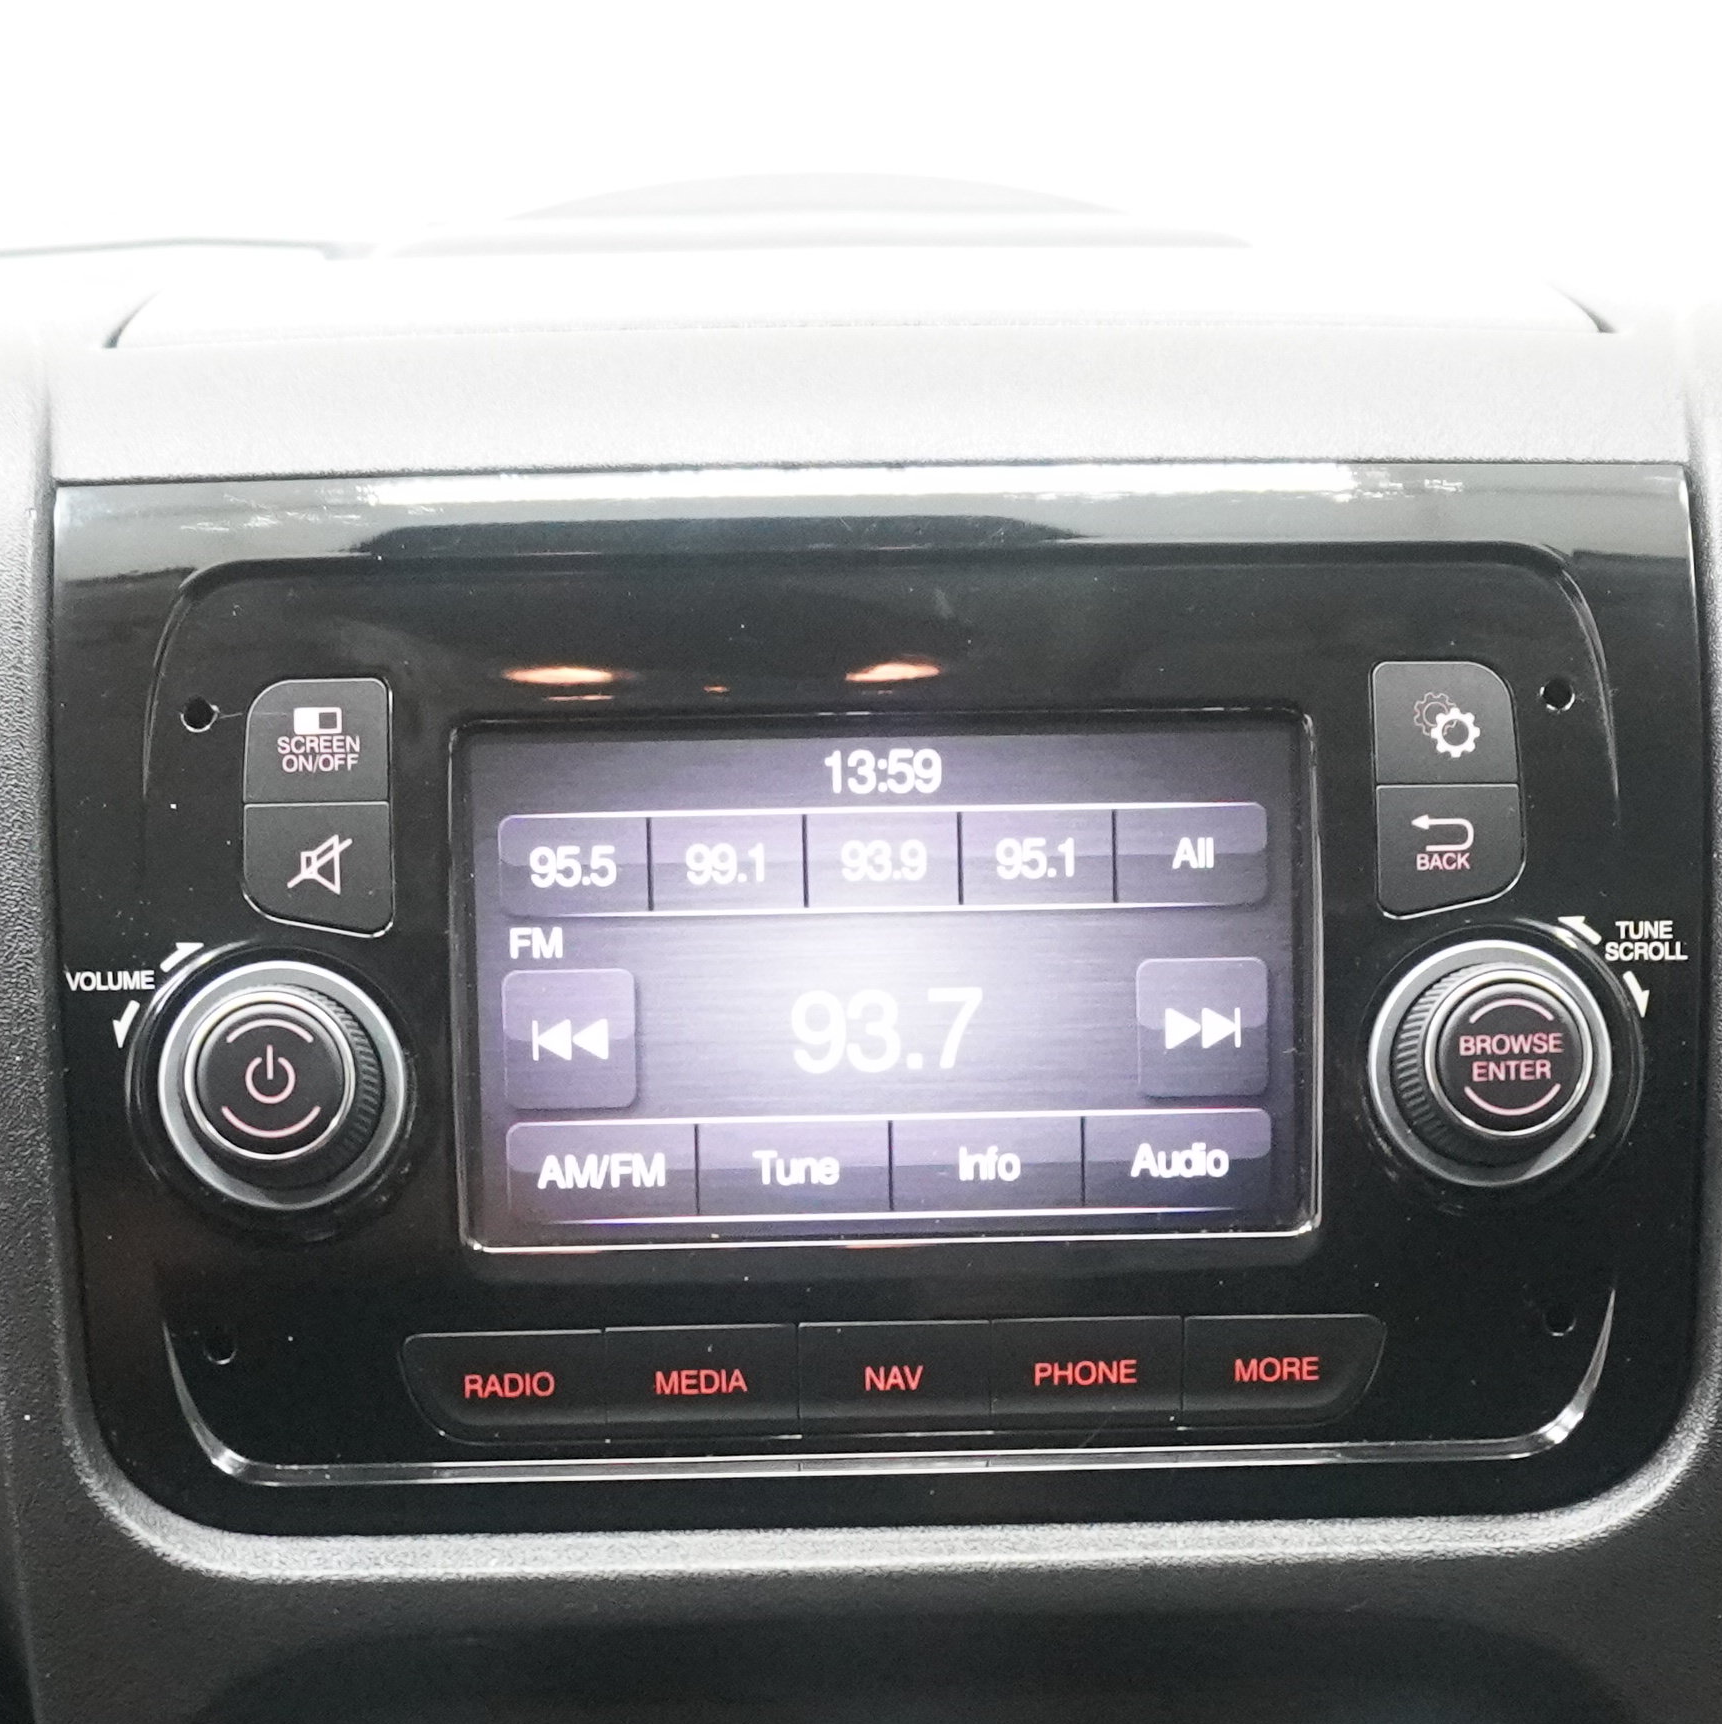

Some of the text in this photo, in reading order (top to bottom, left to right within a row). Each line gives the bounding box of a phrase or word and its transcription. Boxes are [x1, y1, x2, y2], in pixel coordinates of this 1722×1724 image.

[277, 735, 360, 755] SCREEN
[282, 755, 358, 774] ON/OFF
[825, 749, 942, 794] 13:59
[686, 842, 765, 885] 99.1
[838, 839, 927, 882] 93.9
[995, 837, 1077, 880] 95.1
[1172, 837, 1214, 869] All
[1417, 853, 1470, 870] BACK
[530, 845, 616, 888] 95.5
[510, 927, 563, 959] FM
[1615, 921, 1673, 939] TUNE
[1605, 941, 1688, 961] SCROLL
[66, 970, 155, 991] VOLUME
[789, 985, 983, 1075] 93.7
[1460, 1033, 1562, 1055] BROWSE
[1473, 1060, 1551, 1081] ENTER
[537, 1152, 666, 1189] AM/FM
[753, 1149, 840, 1187] Tune
[959, 1144, 1021, 1182] Info
[1131, 1142, 1229, 1178] Audio
[656, 1369, 747, 1394] MEDIA
[865, 1366, 923, 1390] NAV
[1035, 1360, 1137, 1385] PHONE
[1235, 1357, 1318, 1382] MORE
[465, 1372, 554, 1398] RADIO
